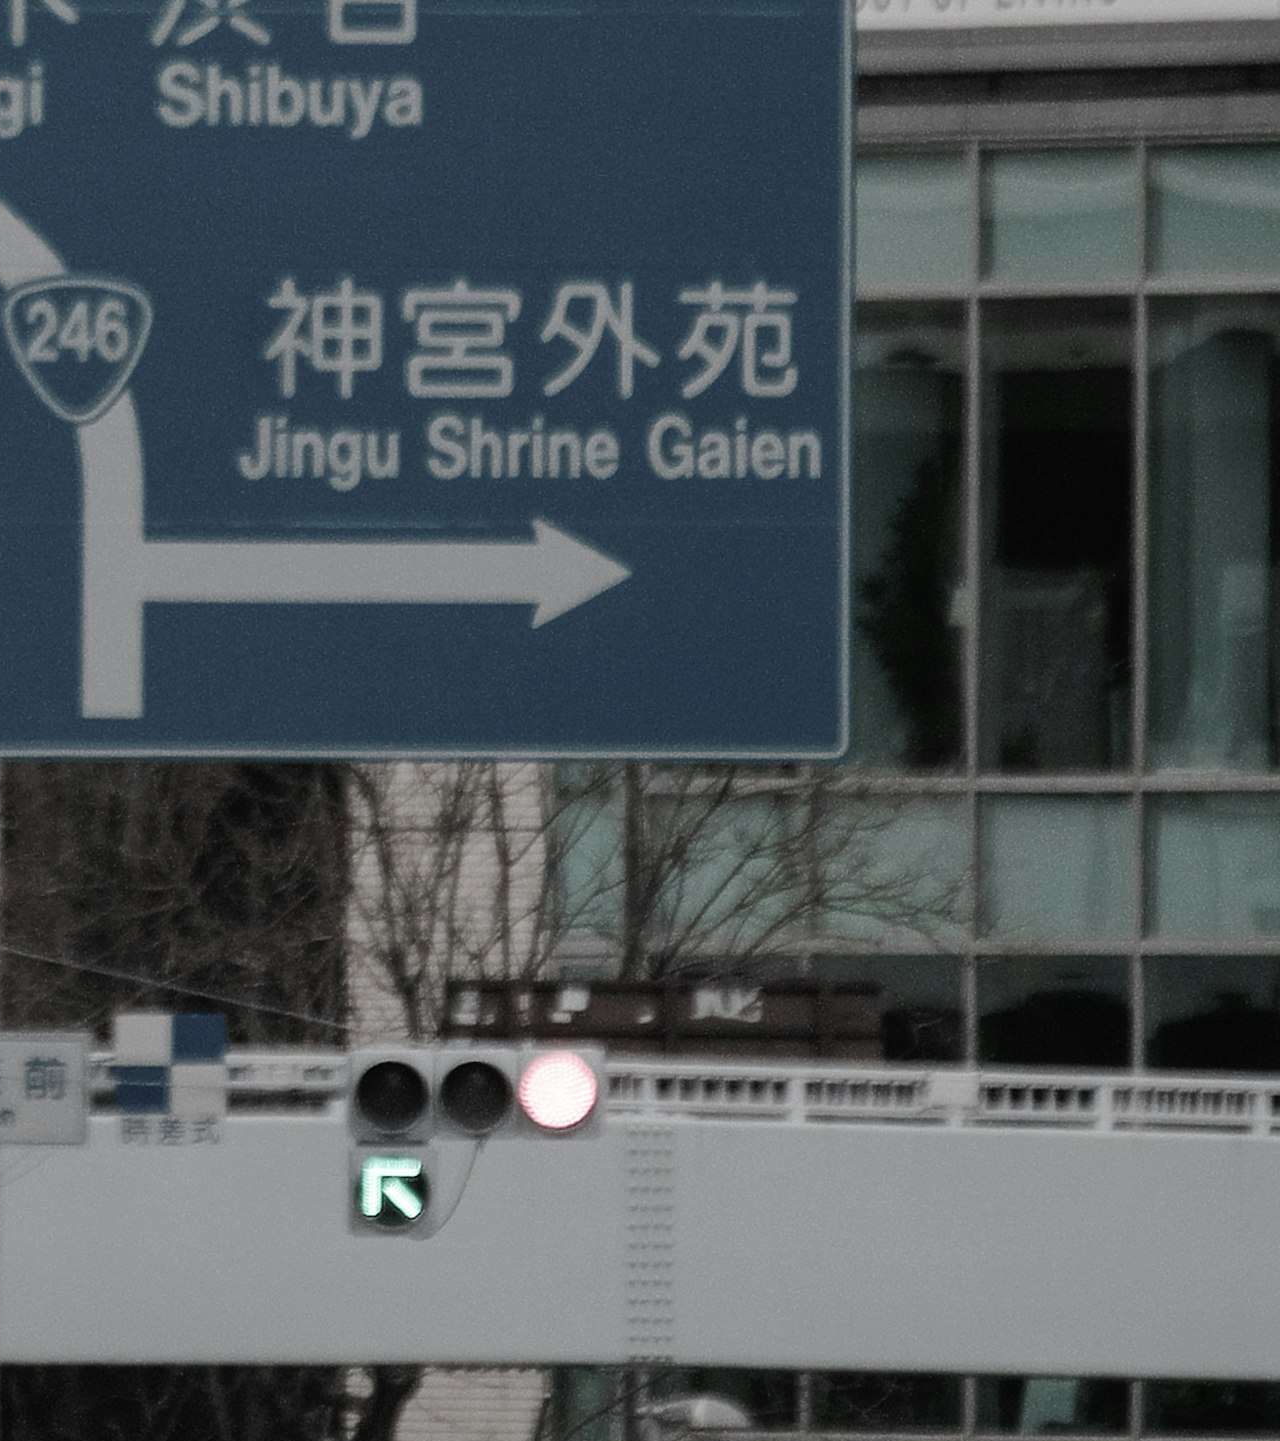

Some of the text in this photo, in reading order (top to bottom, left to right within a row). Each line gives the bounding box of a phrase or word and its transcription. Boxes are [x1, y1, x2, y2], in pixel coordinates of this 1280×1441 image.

[155, 60, 428, 140] Shibuya
[23, 300, 132, 365] 246
[262, 276, 800, 401] 神宮外苑
[238, 414, 823, 492] Jingu Shrine Gaien
